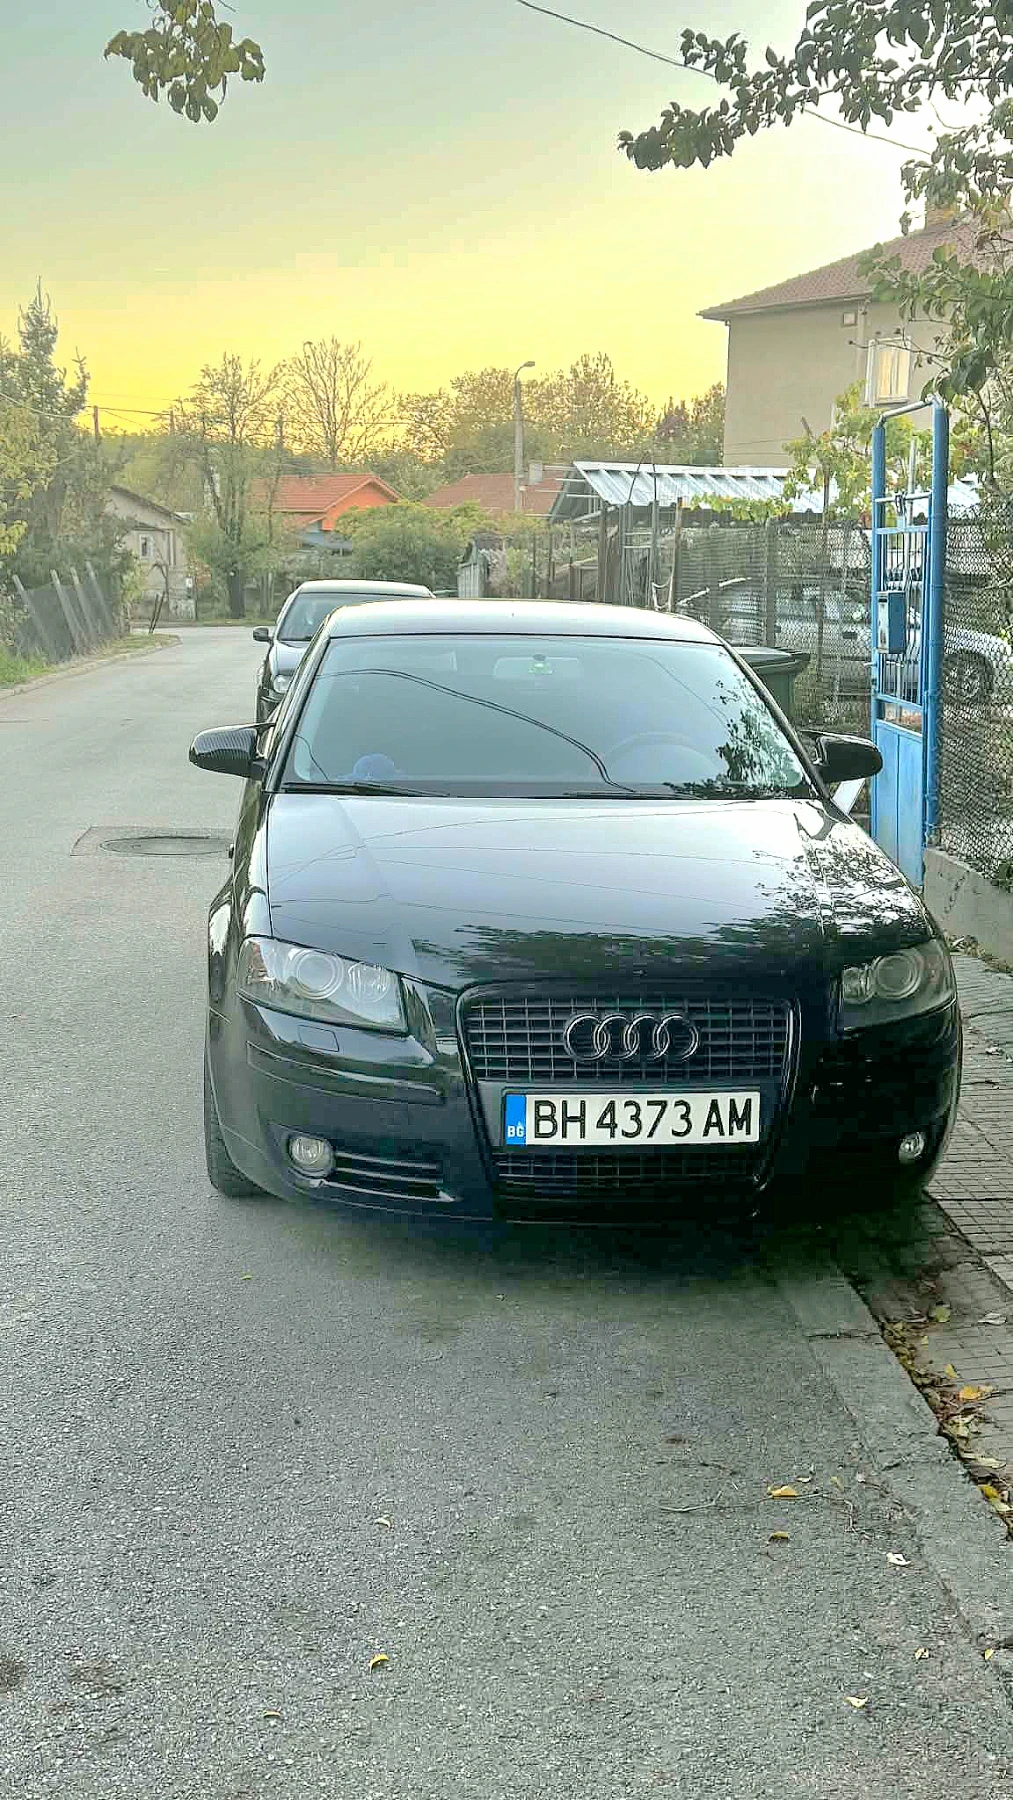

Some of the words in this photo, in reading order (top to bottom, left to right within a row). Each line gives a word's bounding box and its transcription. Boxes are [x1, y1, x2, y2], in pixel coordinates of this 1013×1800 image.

[507, 1125, 525, 1138] BG
[533, 1099, 586, 1139] BH
[596, 1099, 693, 1139] 4373
[702, 1097, 752, 1137] AM
